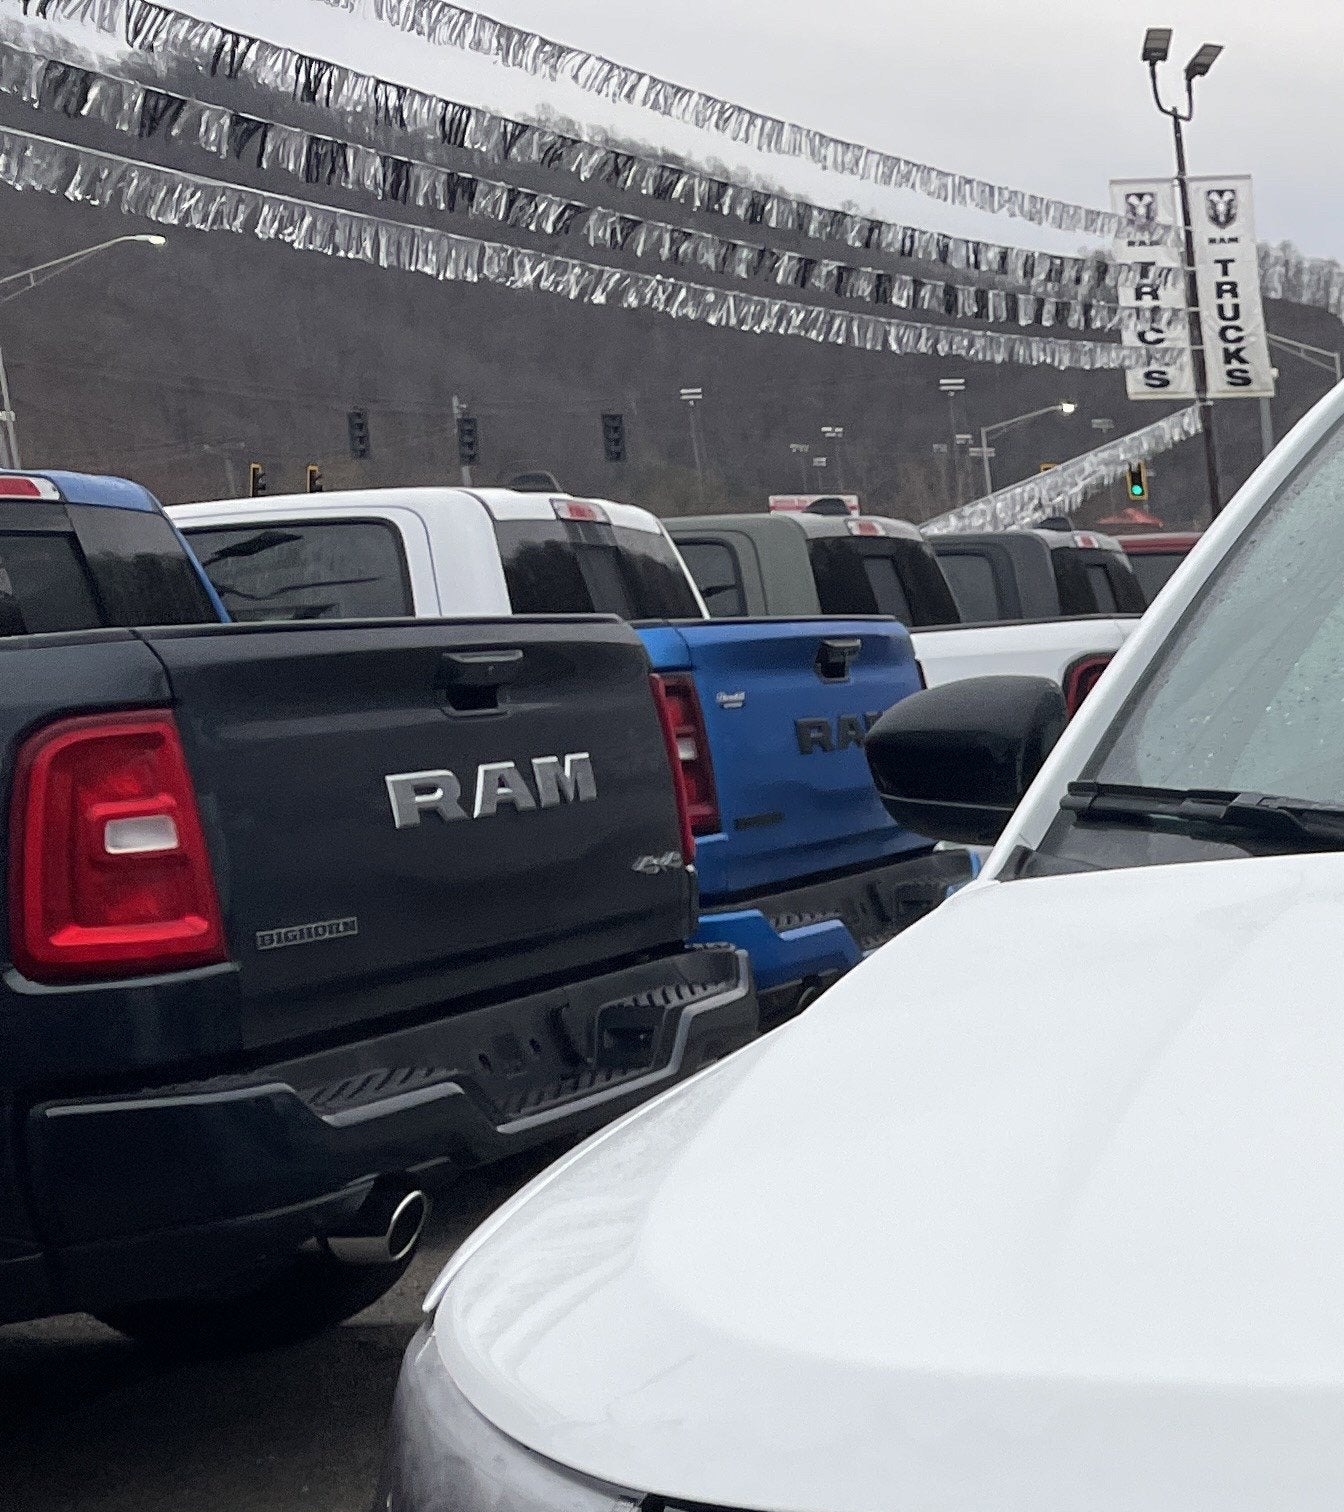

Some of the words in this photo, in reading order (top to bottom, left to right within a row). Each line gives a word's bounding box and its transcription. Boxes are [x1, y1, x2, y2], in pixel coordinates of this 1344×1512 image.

[1134, 260, 1171, 388] TRCS
[1213, 258, 1252, 386] TRUCKS
[795, 710, 884, 755] RA
[385, 752, 598, 829] RAM
